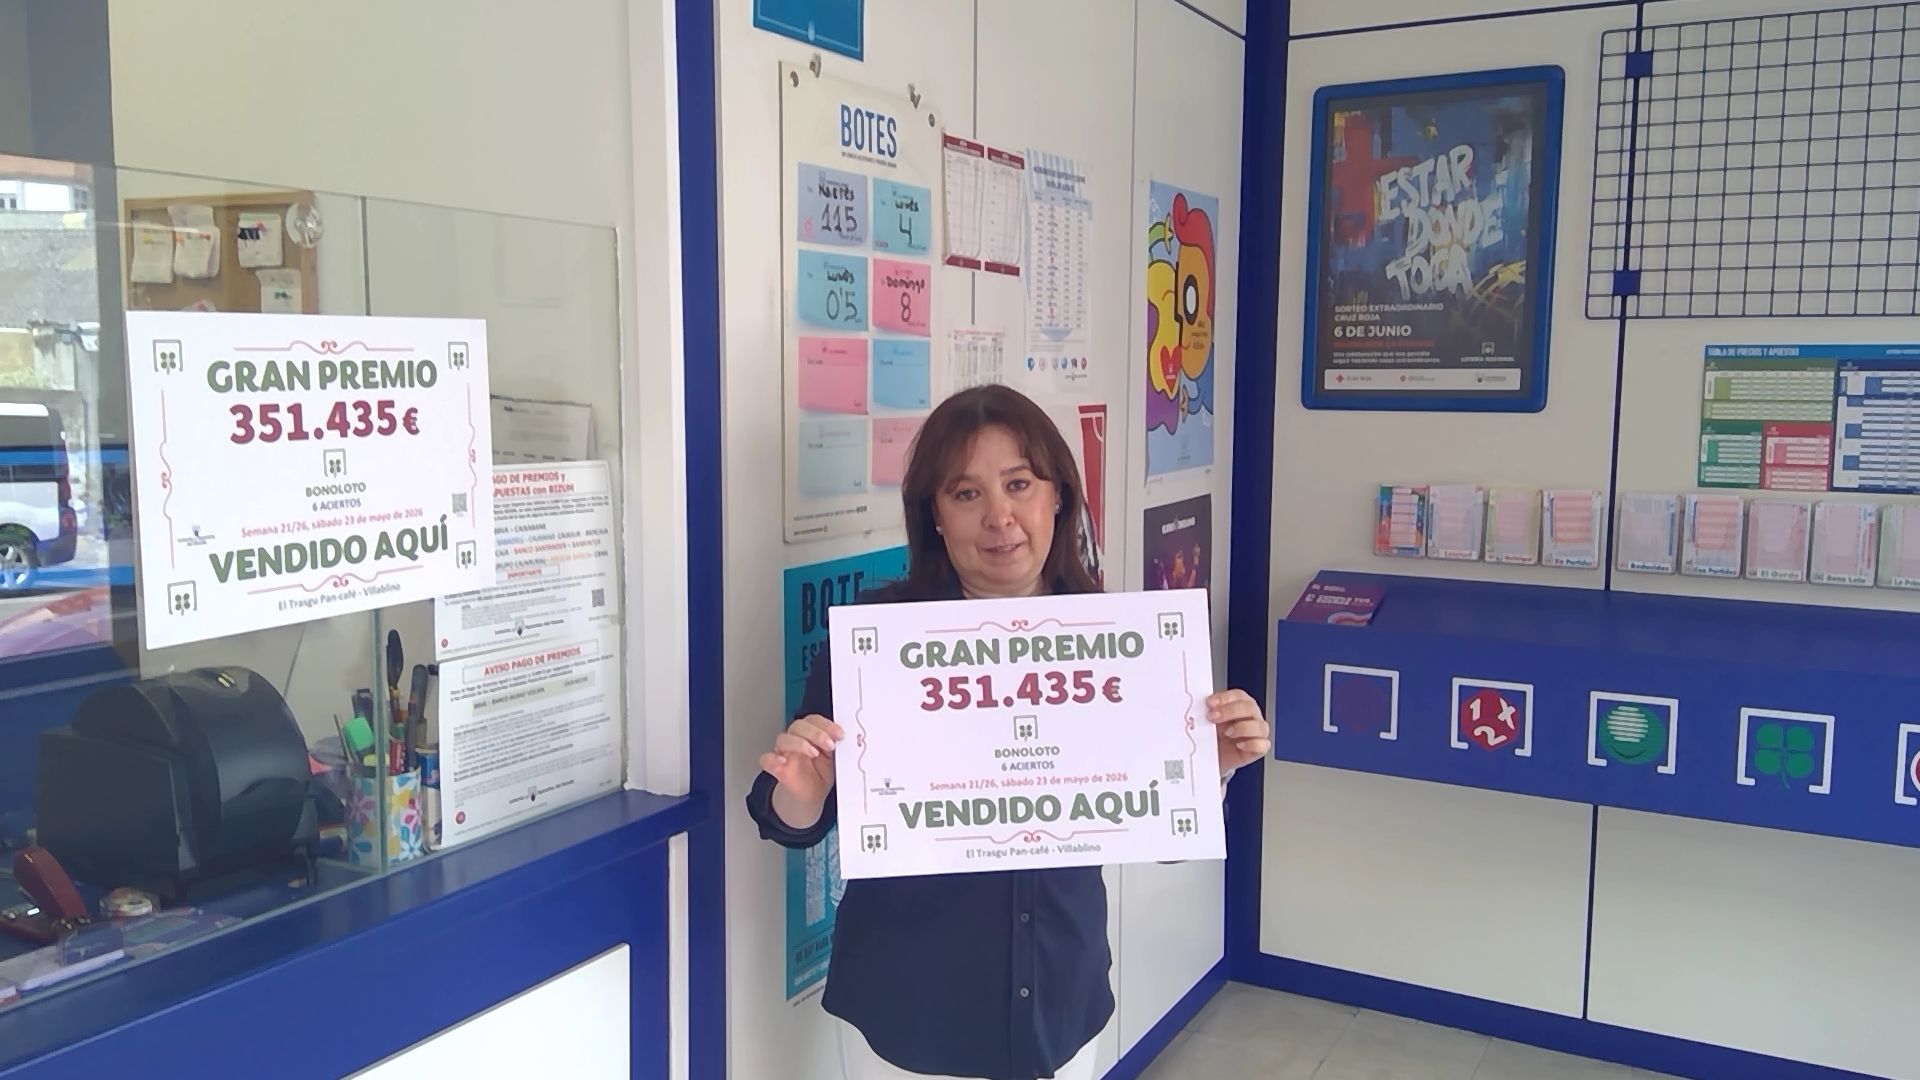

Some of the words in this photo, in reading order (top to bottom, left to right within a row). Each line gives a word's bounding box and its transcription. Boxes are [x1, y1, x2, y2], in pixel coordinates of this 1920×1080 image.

[840, 103, 897, 158] BOTES
[1377, 144, 1473, 224] ESTAR
[821, 203, 857, 232] 115
[899, 212, 913, 247] 4
[1404, 197, 1504, 250] DONDE
[1386, 246, 1473, 299] TOCA
[901, 291, 912, 322] 8
[1335, 304, 1367, 312] SORTEO
[1369, 303, 1444, 312] EXTRAORDINARIO
[1358, 313, 1380, 321] ROJA
[1334, 326, 1343, 338] 6
[1345, 326, 1366, 338] DE
[1367, 324, 1412, 337] JUNIO
[206, 360, 310, 393] GRAN
[318, 359, 438, 390] PREMIO
[305, 481, 366, 498] BONOLOTO
[493, 485, 531, 497] PUESTAS
[533, 486, 547, 495] con
[548, 483, 574, 493] BIZUM
[510, 473, 520, 483] DE
[522, 472, 559, 482] PREMIOS
[312, 502, 318, 511] 6
[320, 498, 362, 512] ACIERTOS
[241, 524, 279, 538] Semana
[281, 520, 309, 536] 21/26,
[311, 514, 343, 531] sábado
[345, 515, 354, 526] 23
[355, 513, 368, 525] de
[370, 512, 391, 526] mayo
[392, 509, 402, 520] de
[404, 507, 424, 519] 2026
[209, 534, 367, 584] VENDIDO
[374, 514, 449, 560] AQUÍ
[278, 599, 286, 611] El
[288, 596, 318, 611] Trasgu
[363, 582, 401, 599] Villablino
[484, 662, 510, 676] AVISO
[511, 657, 533, 671] PAGO
[534, 655, 545, 664] DE
[547, 646, 581, 662] PREMIOS
[899, 637, 1000, 669] GRAN
[1009, 631, 1145, 665] PREMIO
[1470, 698, 1481, 721] 1
[1498, 697, 1516, 730] X
[1474, 726, 1507, 746] 2
[994, 745, 1060, 759] BONOLOTO
[1001, 762, 1007, 772] 6
[1009, 760, 1056, 771] ACIERTOS
[929, 780, 967, 792] Semana
[969, 778, 999, 791] 21/26,
[1000, 774, 1034, 789] sábado
[1035, 775, 1047, 786] 23
[1049, 774, 1060, 785] de
[1062, 774, 1089, 787] mayo
[1091, 772, 1103, 783] de
[1105, 771, 1128, 783] 2026
[898, 793, 1062, 829] VENDIDO
[1069, 779, 1160, 824] AQUÍ
[966, 848, 974, 859] El
[976, 847, 1008, 861] Trasgu
[1010, 844, 1049, 857] Pan-café
[1056, 842, 1102, 854] Villablino
